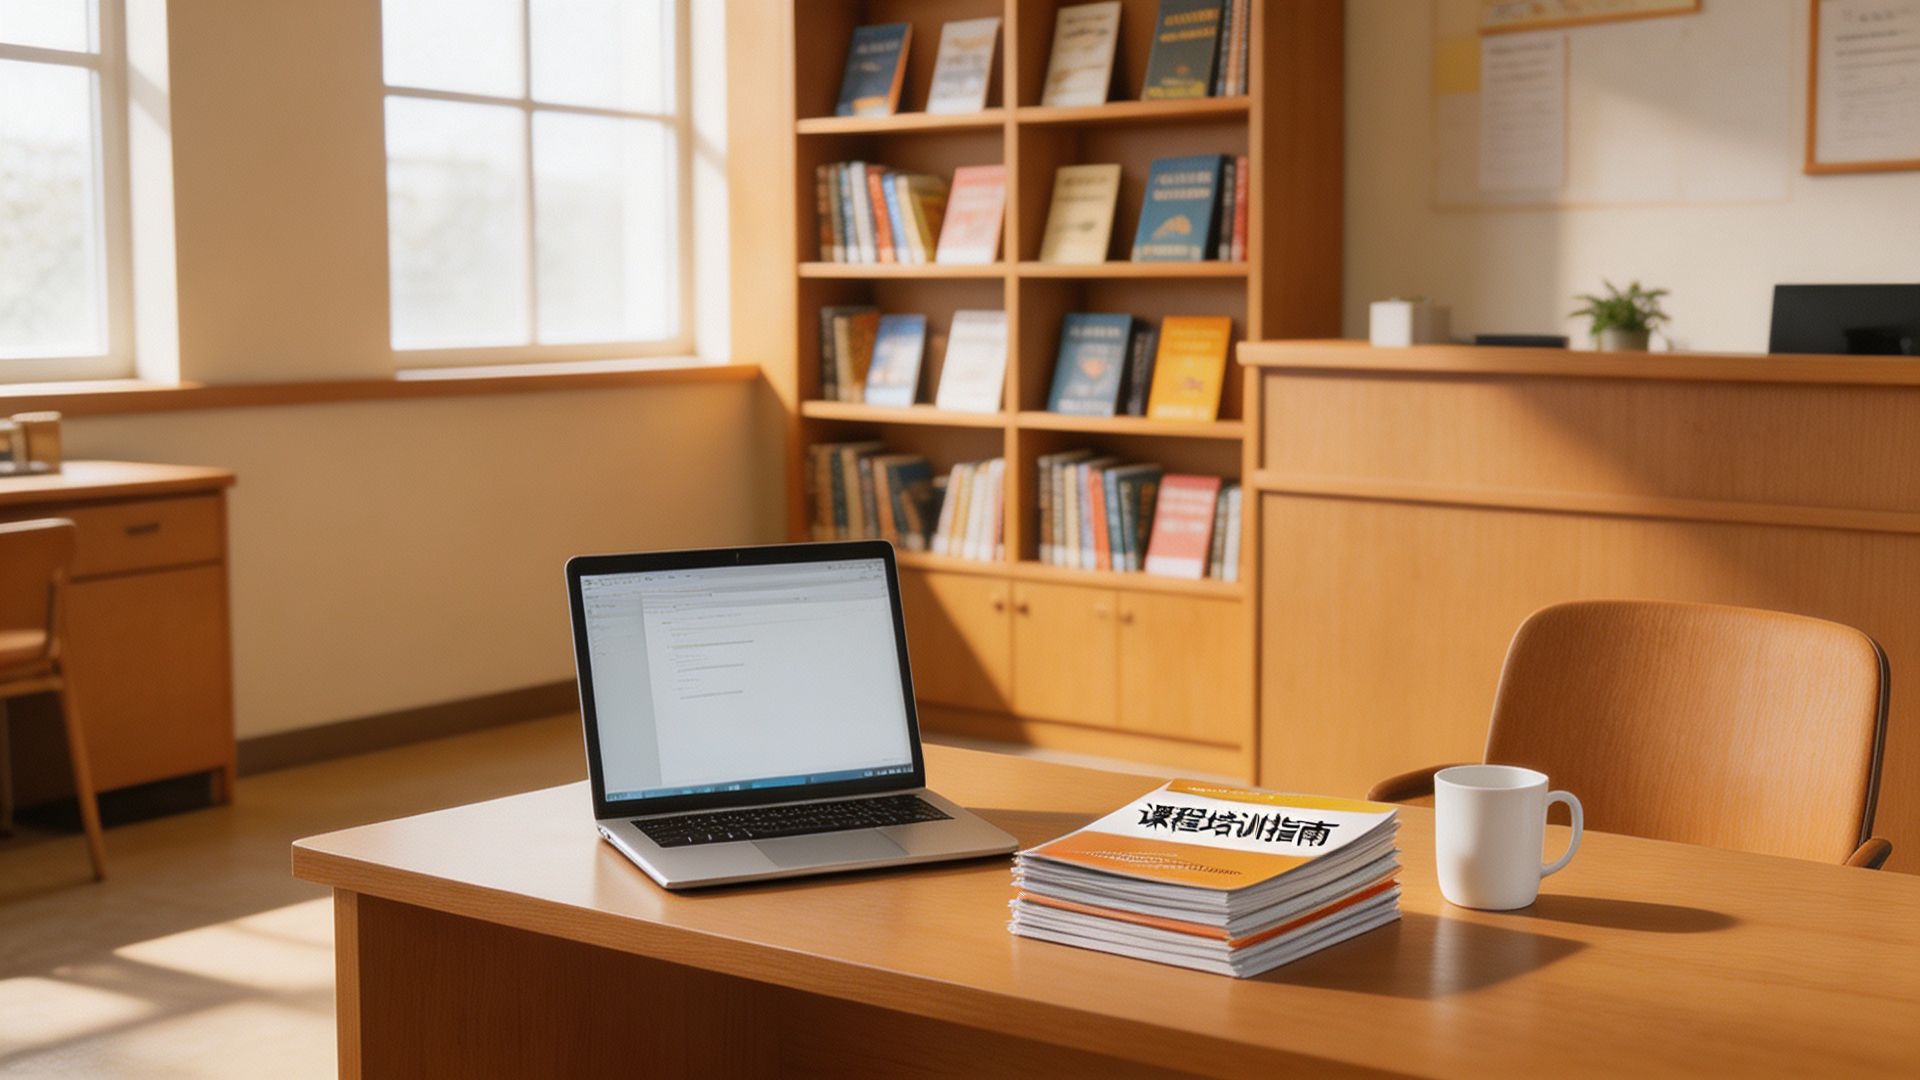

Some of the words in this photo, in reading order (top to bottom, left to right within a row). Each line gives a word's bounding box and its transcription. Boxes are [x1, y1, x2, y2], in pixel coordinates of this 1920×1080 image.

[1138, 803, 1339, 846] 课程培训指南
